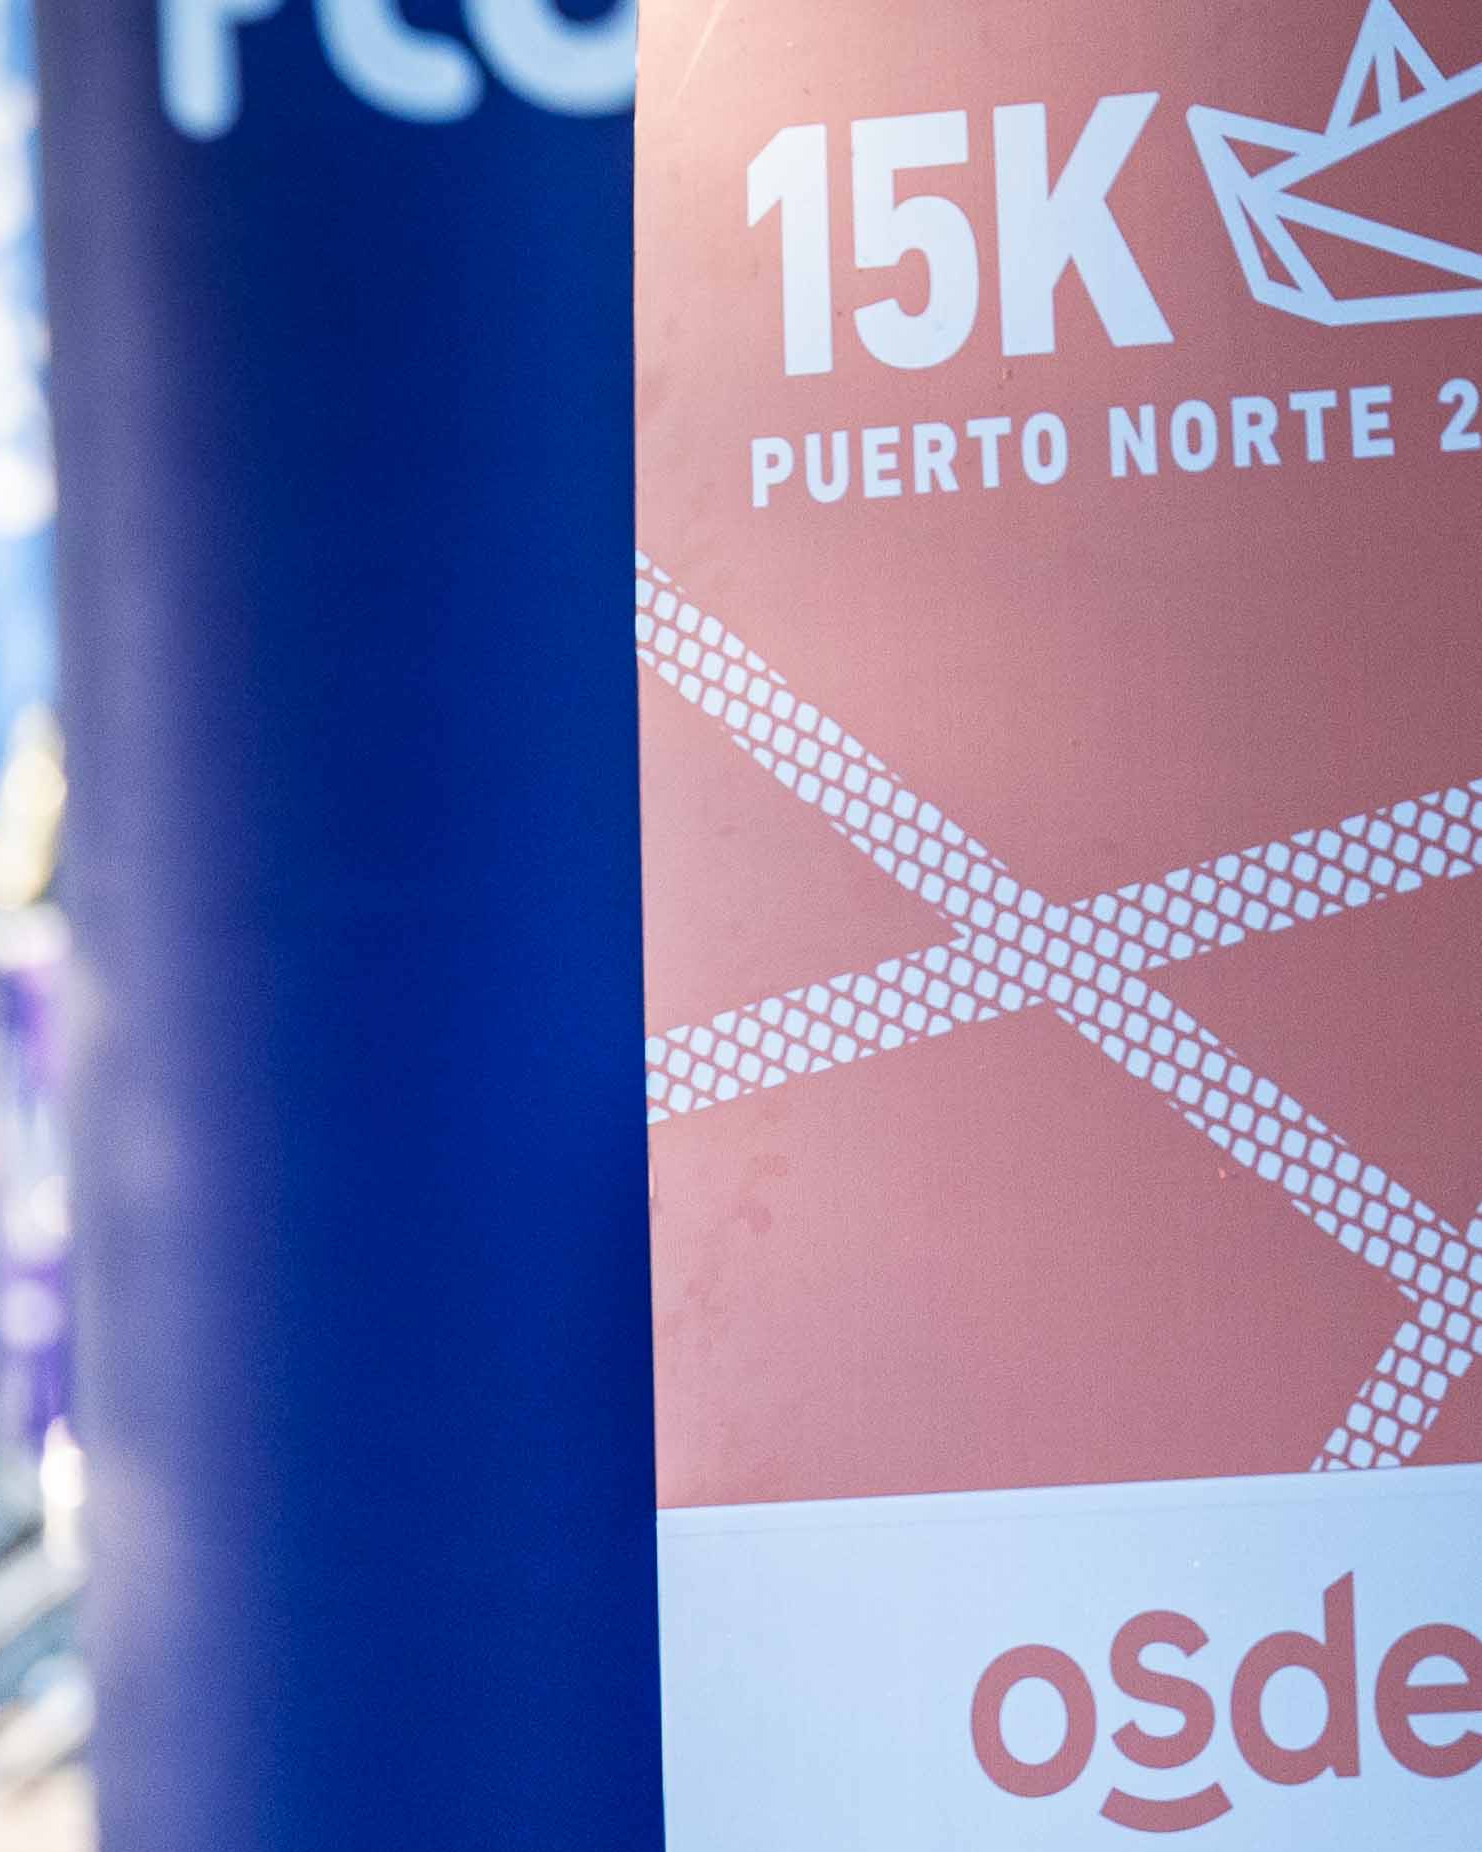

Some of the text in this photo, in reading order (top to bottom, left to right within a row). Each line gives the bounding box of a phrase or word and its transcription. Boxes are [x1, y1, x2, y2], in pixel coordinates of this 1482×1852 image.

[747, 91, 1175, 377] 15K
[751, 411, 1069, 508] PUERTO
[1108, 385, 1395, 478] NORTE
[969, 1569, 1482, 1799] osde
